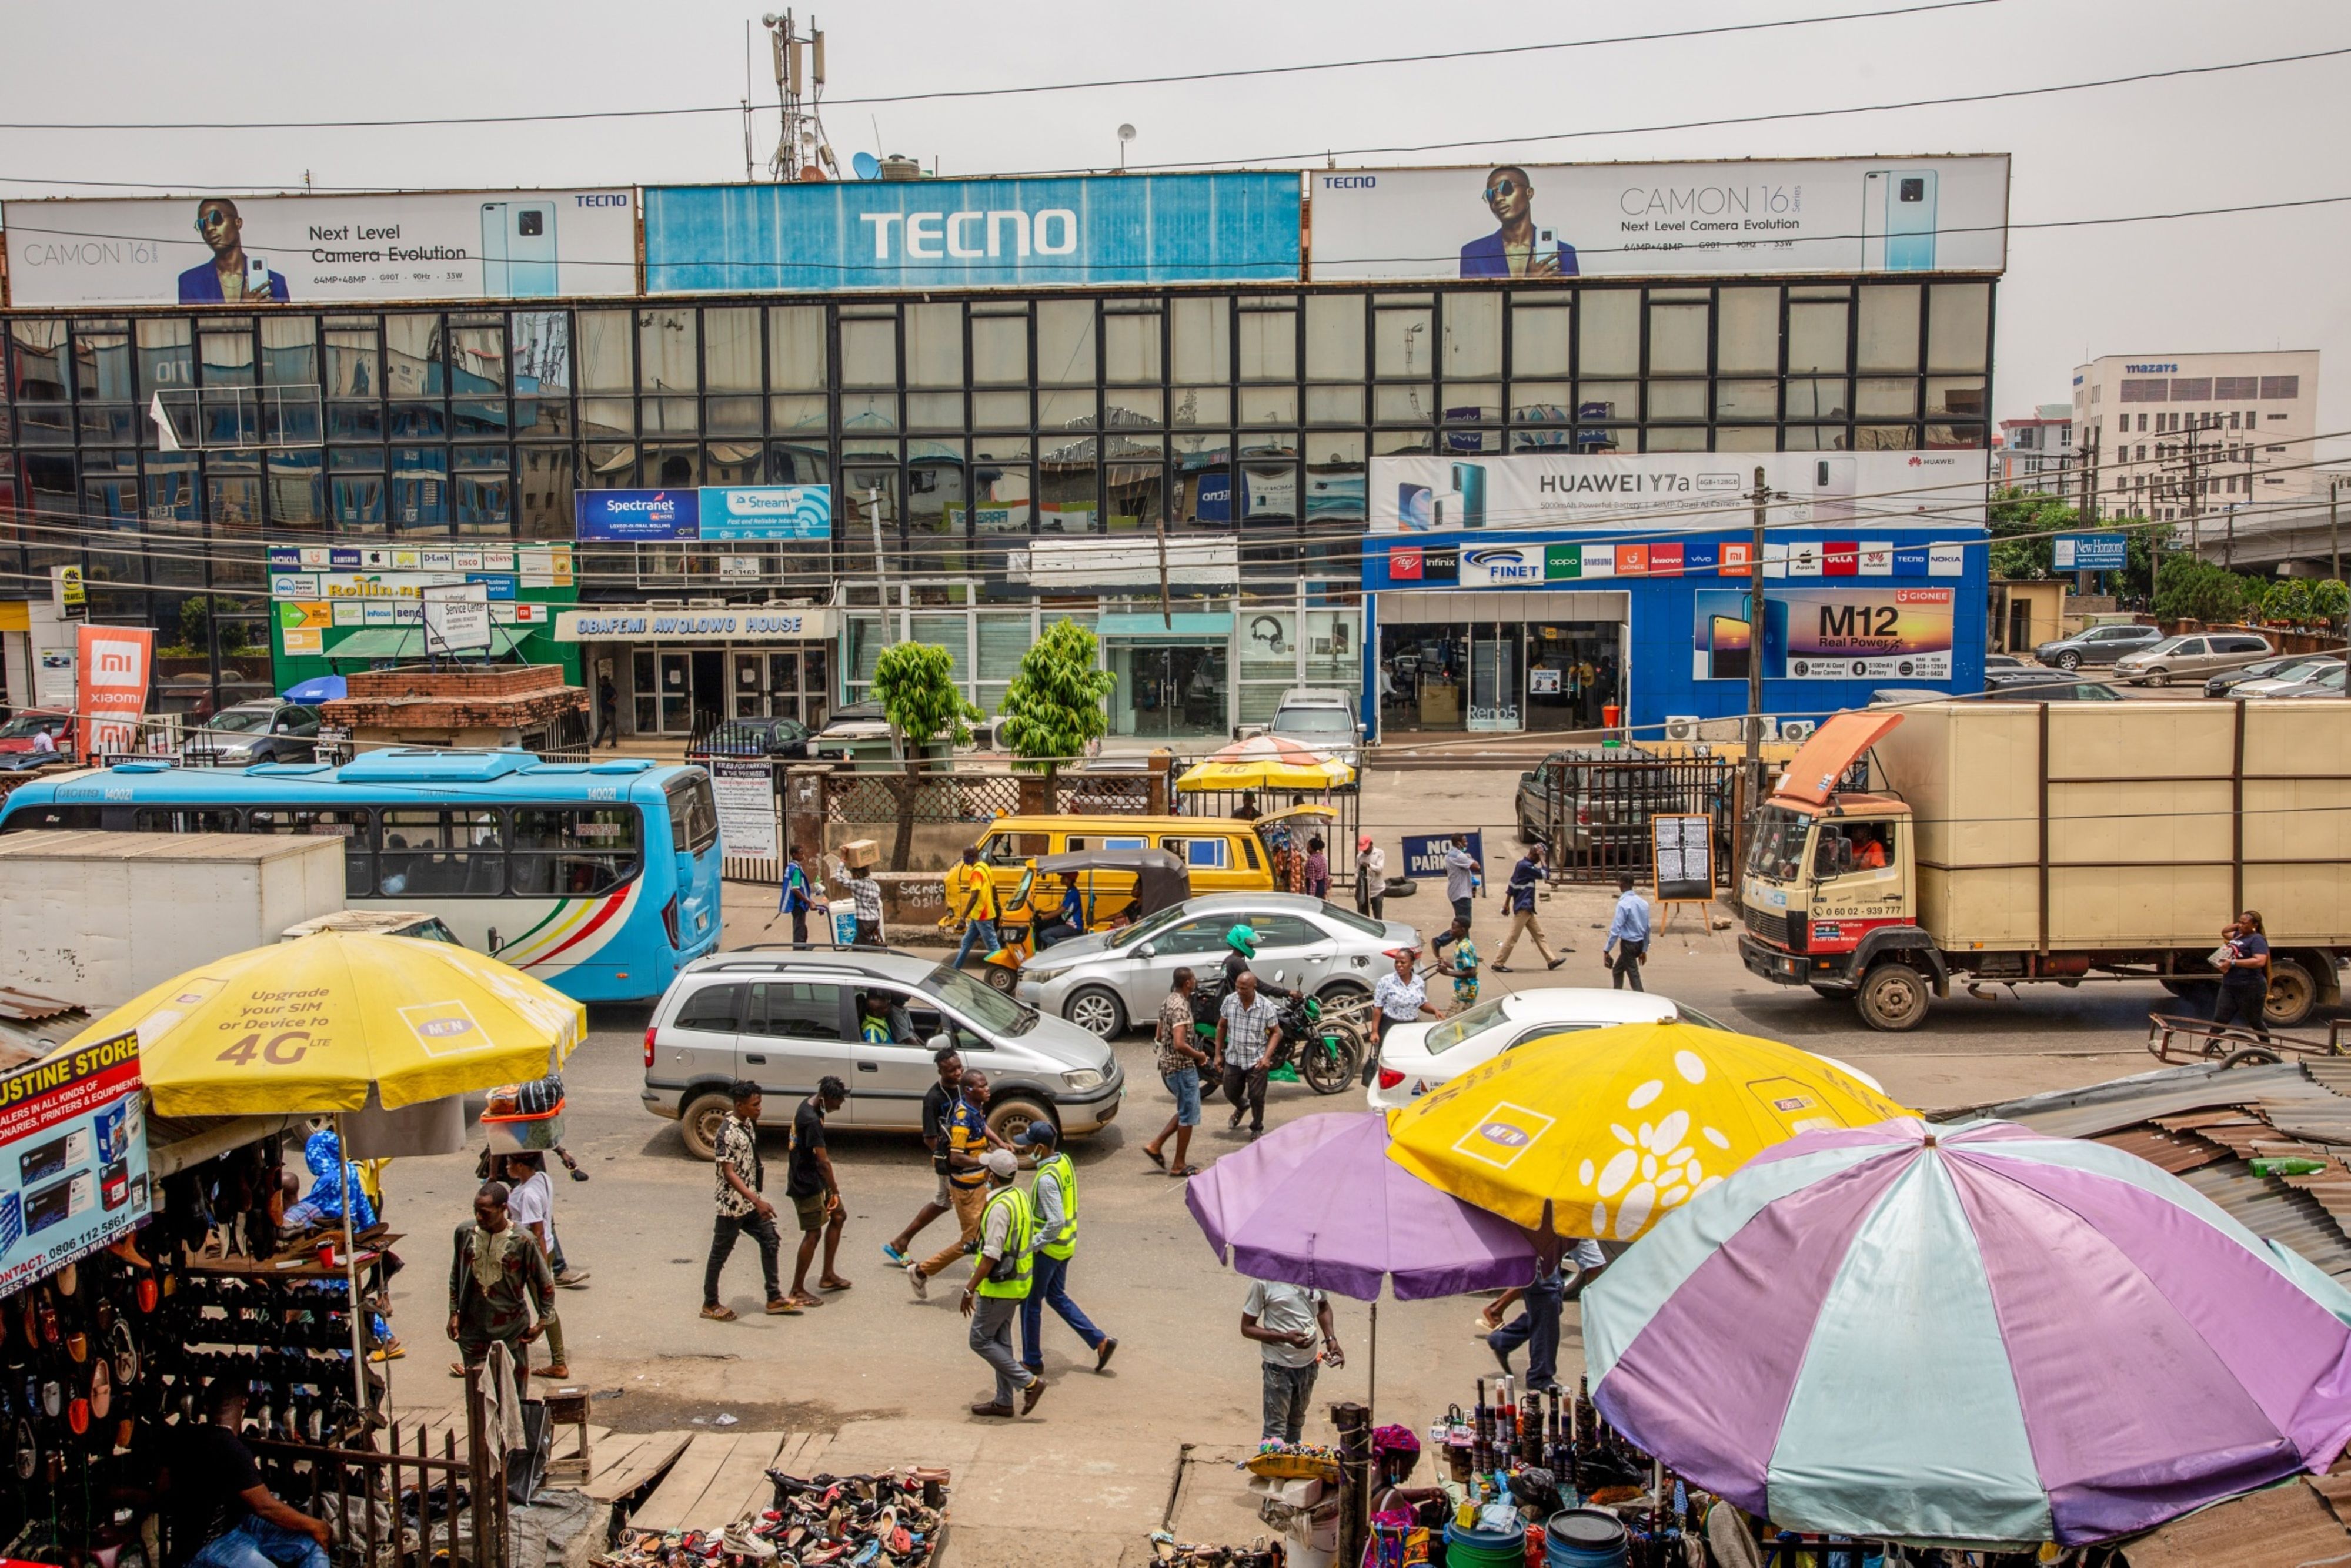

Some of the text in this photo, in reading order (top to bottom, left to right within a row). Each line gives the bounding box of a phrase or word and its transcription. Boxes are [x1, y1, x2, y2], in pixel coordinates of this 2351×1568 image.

[1323, 176, 1375, 188] TECNO
[575, 195, 627, 208] TECNO
[1621, 185, 1789, 216] CAMON 16
[1792, 185, 1802, 213] Series
[1621, 218, 1799, 232] Next Level Camera Evolution
[309, 224, 400, 241] Next Level
[860, 208, 1077, 259] TECNO
[24, 242, 149, 266] CAMON 16
[312, 246, 466, 263] Camera Evolution
[313, 275, 366, 285] 64MP+48MP
[446, 272, 463, 280] 33W
[2125, 362, 2178, 373] mazars
[1539, 473, 1690, 493] HUAWEI Y7a
[607, 500, 674, 513] Spectranet
[749, 496, 789, 508] Stream
[2076, 539, 2123, 553] New Horizons
[424, 554, 450, 562] D-Link
[1426, 558, 1455, 566] Infinix
[1549, 559, 1578, 567] oppo
[1583, 557, 1613, 566] SAMSUNG
[1651, 556, 1682, 564] lenovo
[1490, 566, 1539, 577] FINET
[1909, 591, 1948, 600] GIONEE
[445, 604, 466, 616] Service
[577, 616, 803, 635] OBAFEMI AWOLOWO HOUSE
[1819, 604, 1899, 637] M12
[1819, 637, 1888, 648] Real Power
[1470, 706, 1518, 720] Reno5
[105, 788, 133, 800] 140021
[587, 787, 617, 801] 140021
[1427, 840, 1452, 855] NO
[1411, 854, 1448, 872] PARK
[1847, 907, 1858, 915] 02
[1866, 907, 1882, 915] 939
[1885, 906, 1901, 914] 777
[251, 988, 330, 1002] Upgrade
[240, 1002, 323, 1017] your SIM
[218, 1017, 329, 1030] or Device to
[428, 1019, 465, 1037] MTN
[75, 1034, 139, 1076] STORE
[216, 1031, 332, 1066] 4G LTE
[31, 1102, 40, 1114] IN
[42, 1096, 58, 1110] ALL
[59, 1085, 85, 1104] KINDS
[86, 1079, 98, 1093] OF
[41, 1099, 82, 1124] PRINTERS
[84, 1097, 90, 1106] &
[91, 1075, 142, 1103] EQUIPMENTS
[1486, 1124, 1524, 1146] MTN
[49, 1238, 76, 1260] 0806
[79, 1227, 99, 1245] 112
[102, 1213, 126, 1233] 5861
[41, 1248, 88, 1278] AWOLOWO
[89, 1237, 111, 1256] WAY,
